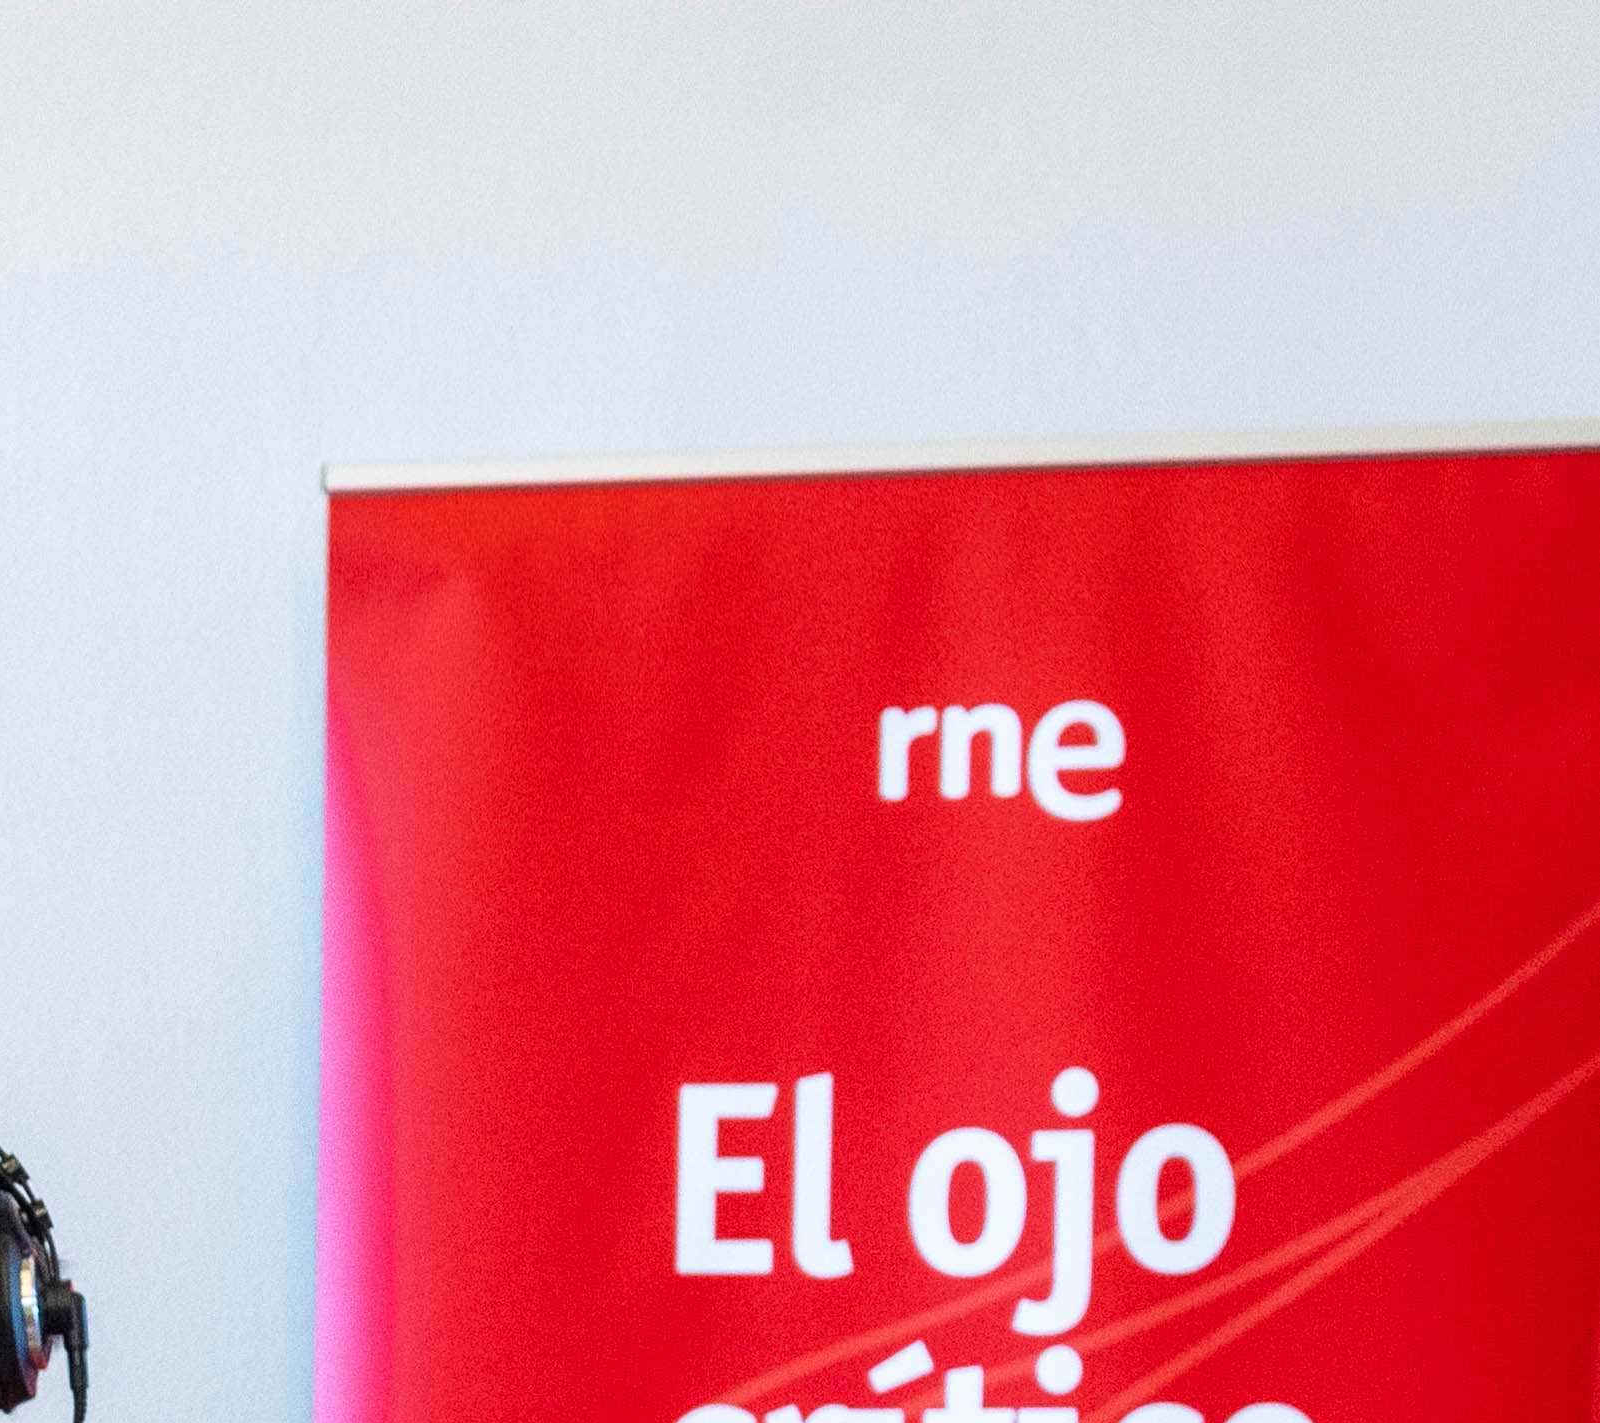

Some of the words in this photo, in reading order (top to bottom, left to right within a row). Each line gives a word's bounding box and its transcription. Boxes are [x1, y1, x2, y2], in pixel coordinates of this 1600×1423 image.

[878, 699, 1125, 822] rne
[675, 1073, 854, 1279] El
[908, 1066, 1235, 1337] ojo
